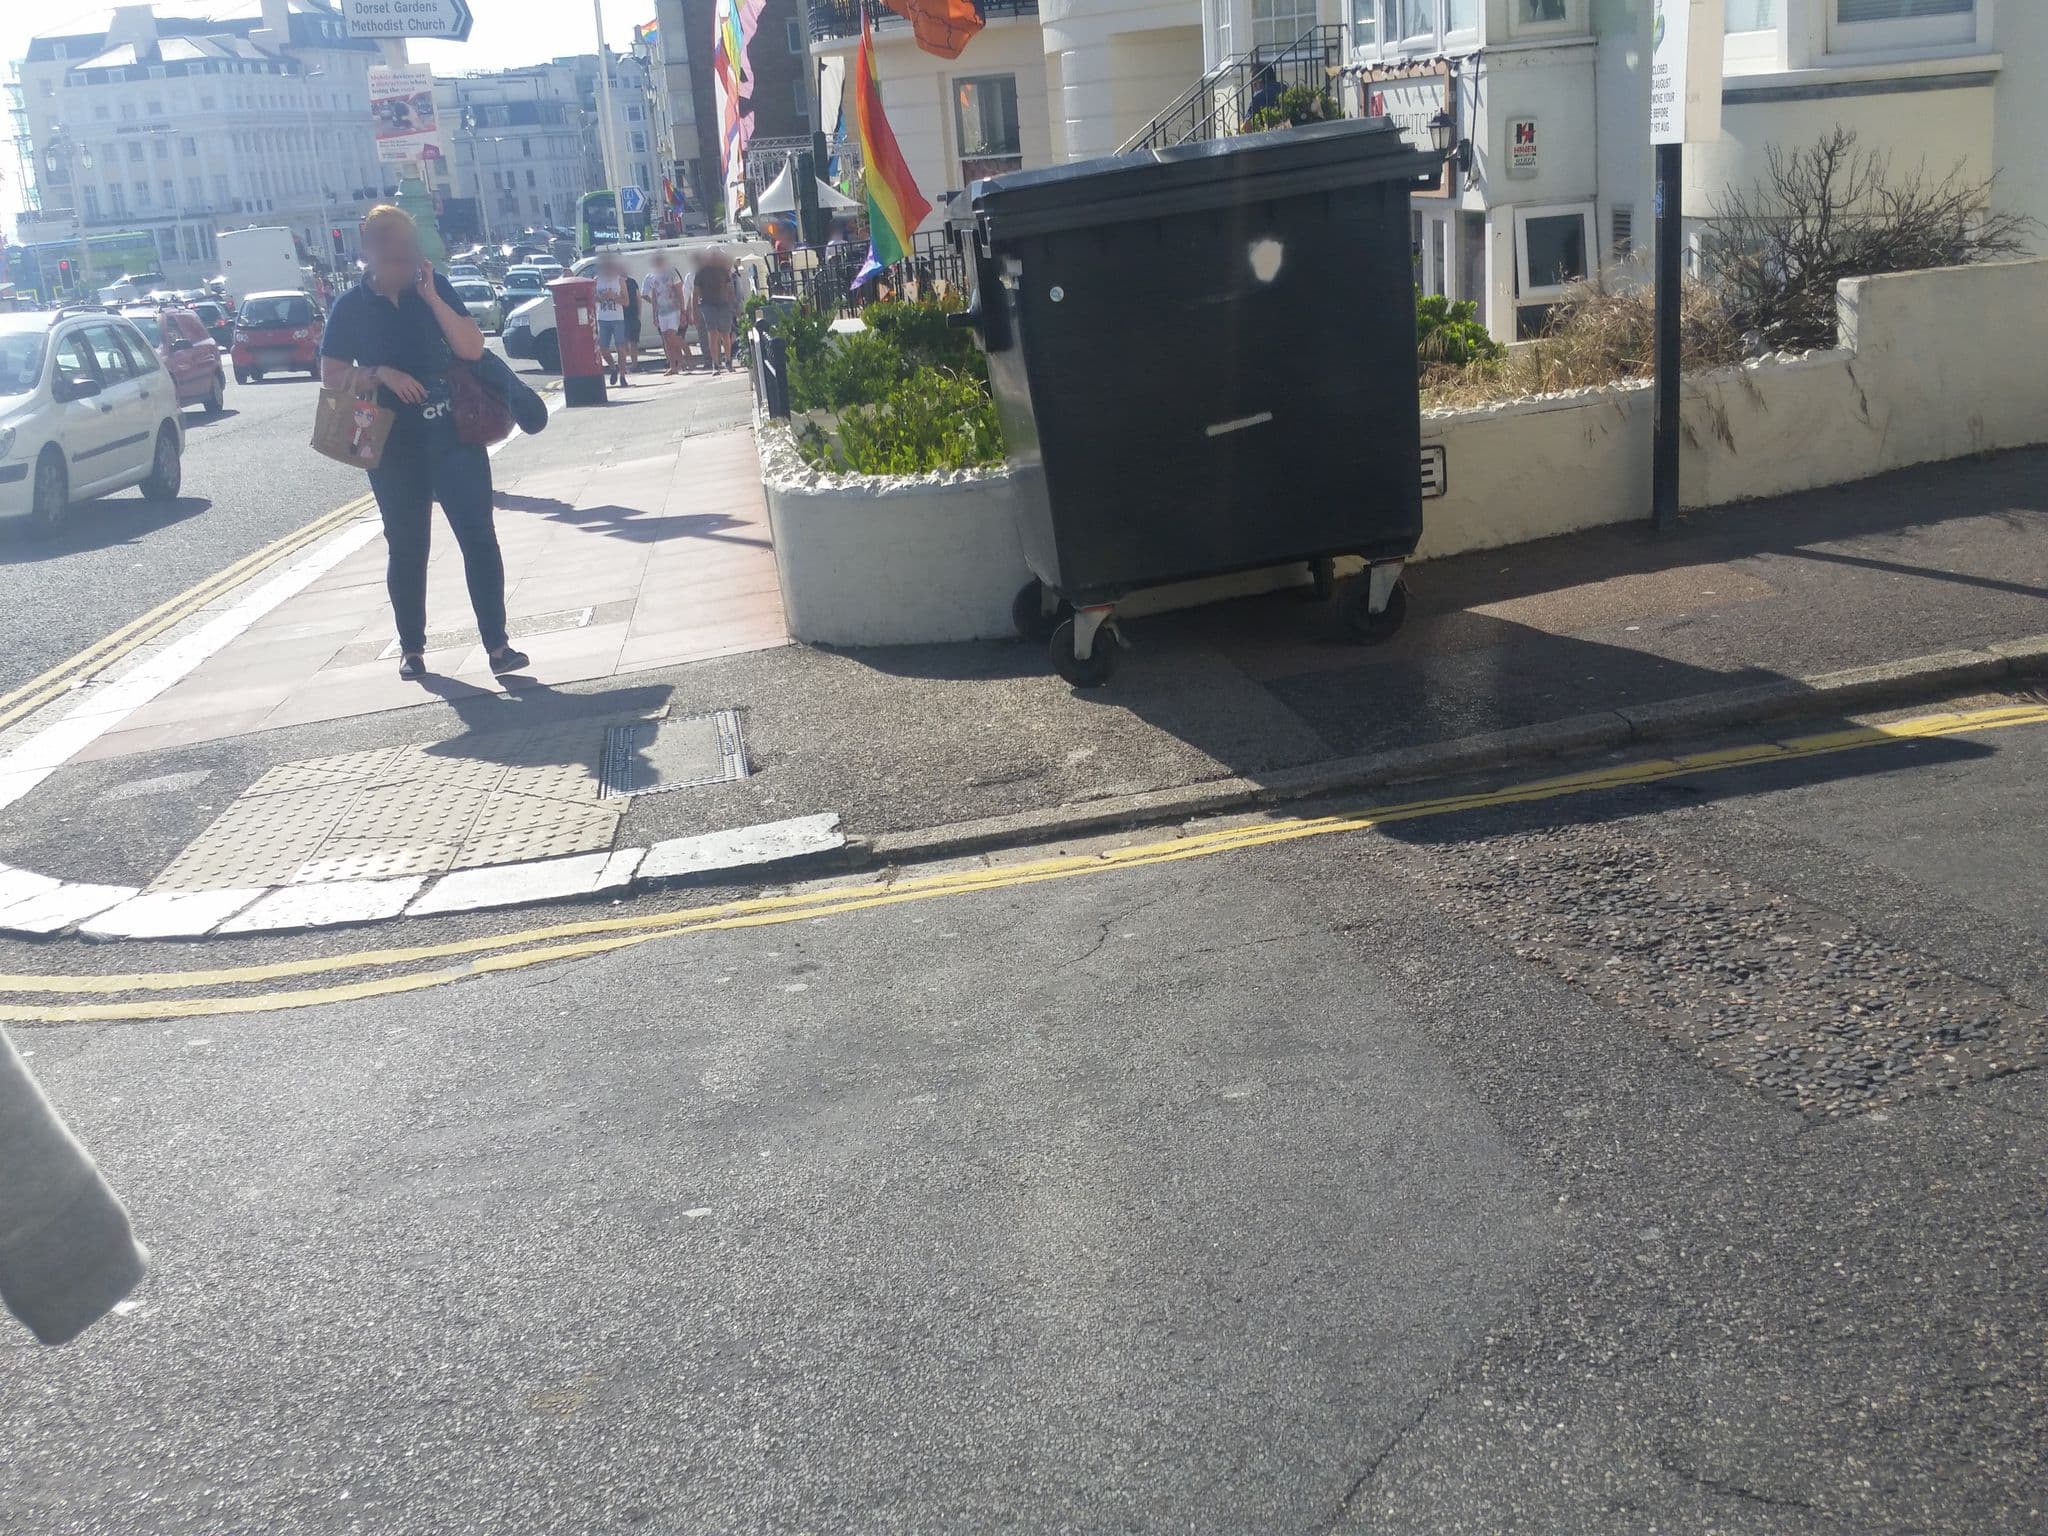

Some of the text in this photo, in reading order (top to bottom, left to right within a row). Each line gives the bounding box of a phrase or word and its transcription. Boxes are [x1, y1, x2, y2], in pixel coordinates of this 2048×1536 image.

[355, 0, 438, 14] Dorset Gardens
[351, 18, 446, 32] Methodist Church
[1655, 77, 1671, 89] AUGUST
[1513, 145, 1537, 154] HAVEN
[632, 231, 642, 241] 12
